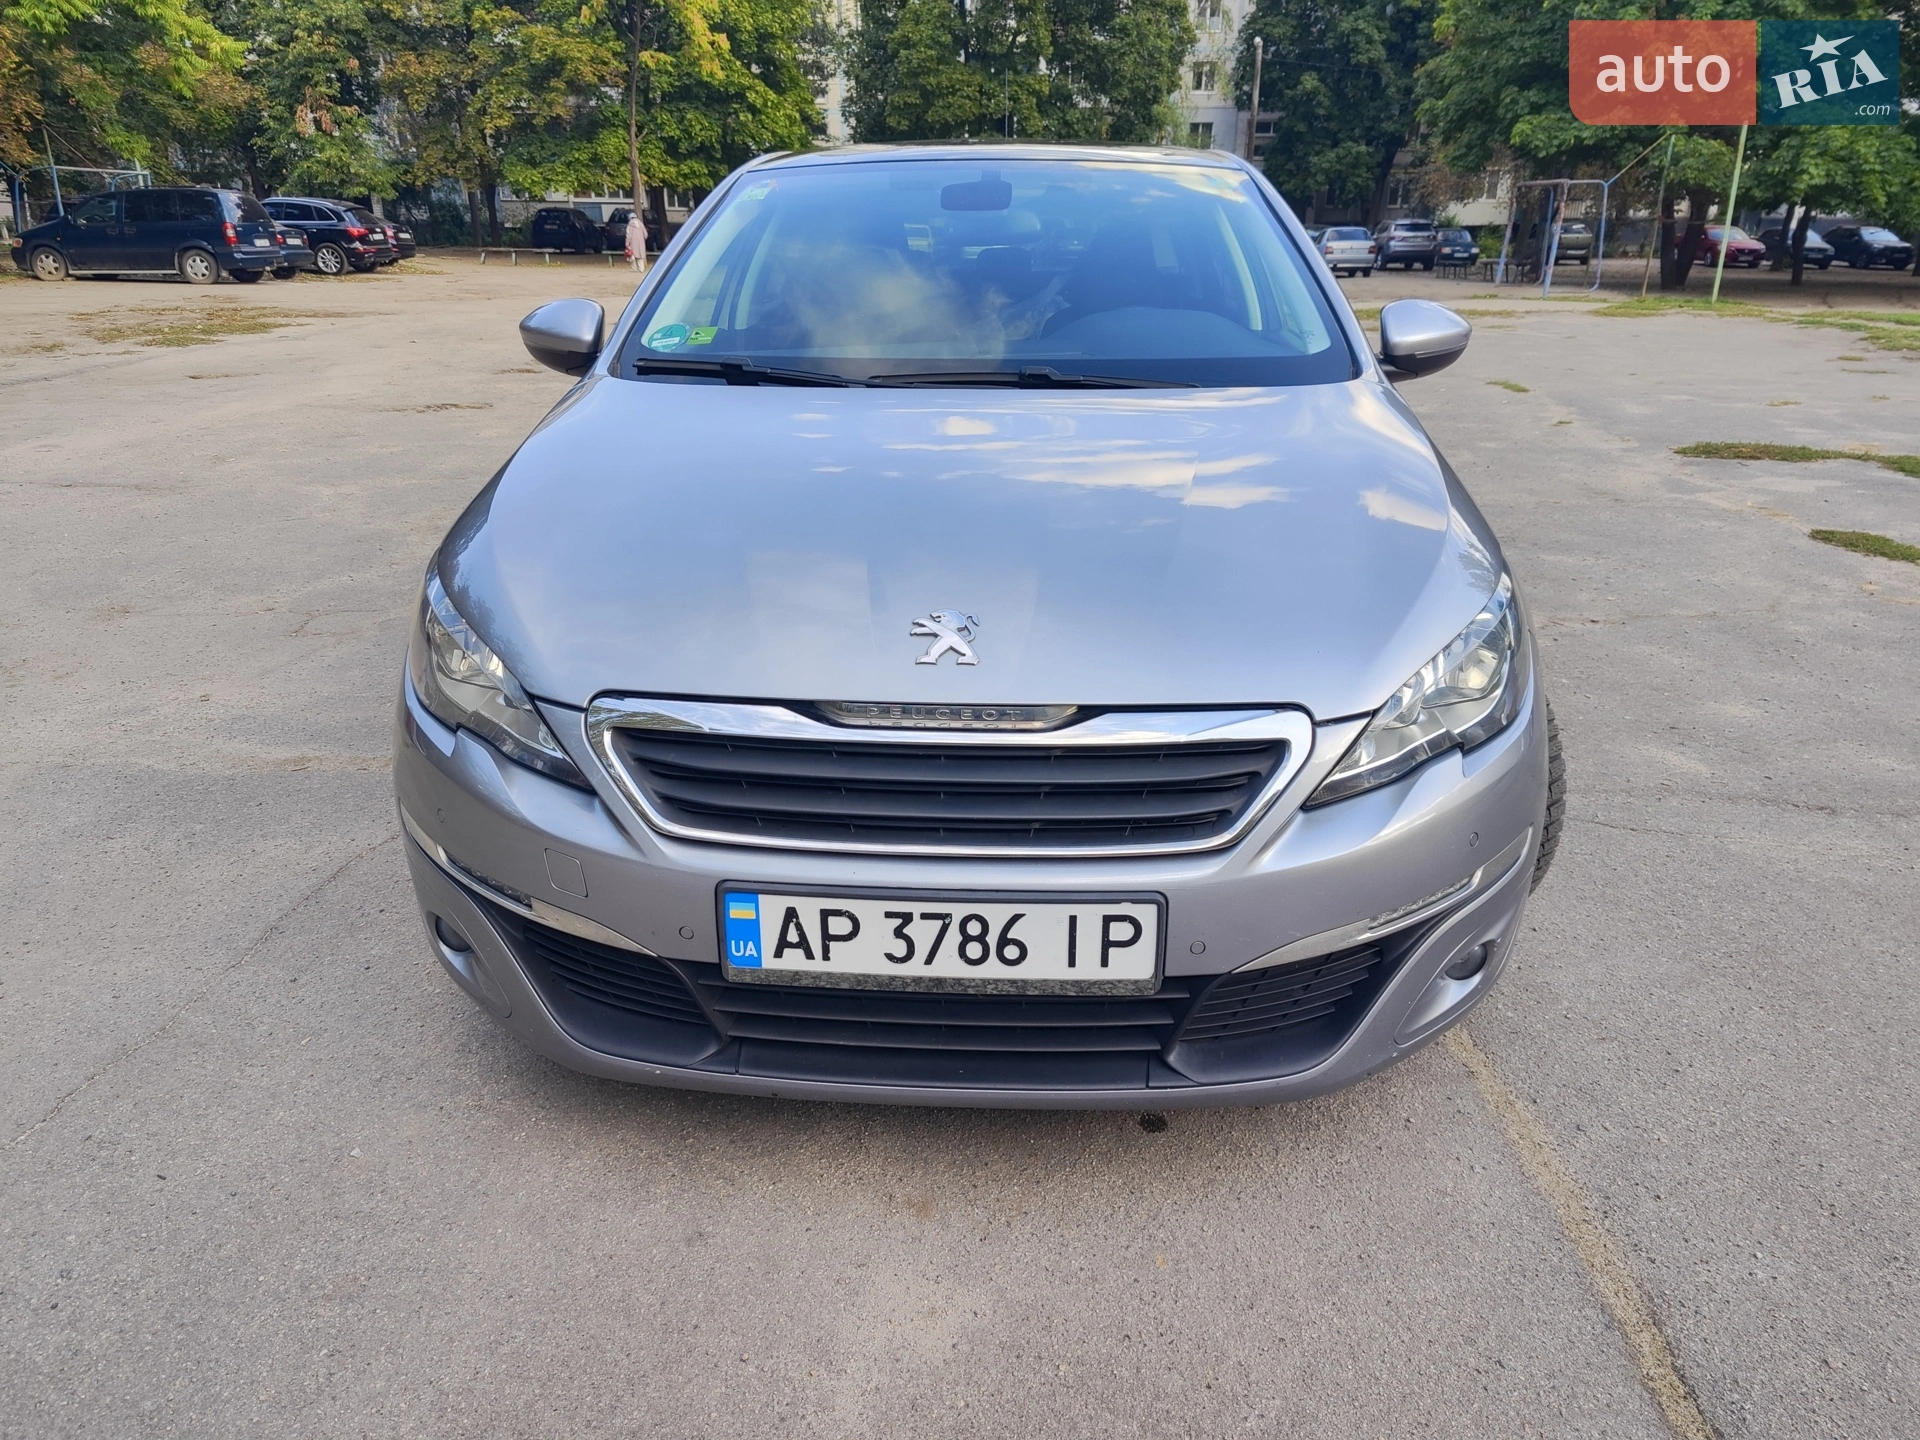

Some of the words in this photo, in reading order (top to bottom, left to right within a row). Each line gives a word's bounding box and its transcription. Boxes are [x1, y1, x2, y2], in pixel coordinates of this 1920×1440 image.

[866, 705, 1022, 721] PEUGEOT
[773, 906, 861, 962] AP
[883, 910, 1029, 967] 3786
[1067, 914, 1144, 969] IP
[731, 939, 758, 958] UA
